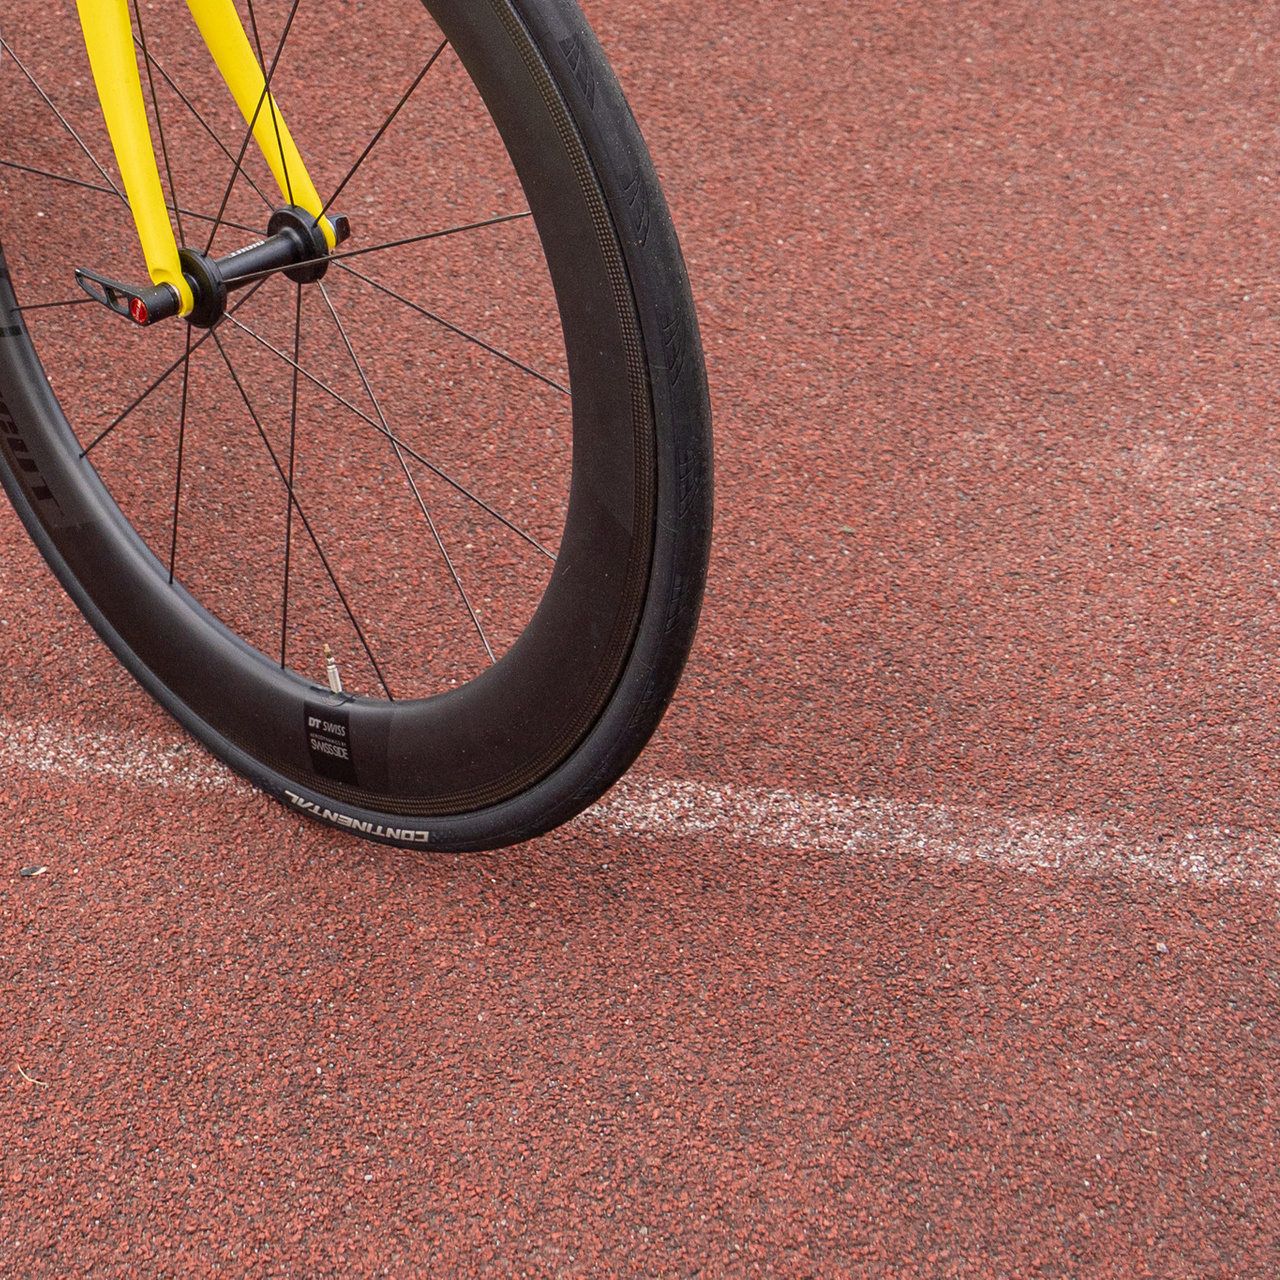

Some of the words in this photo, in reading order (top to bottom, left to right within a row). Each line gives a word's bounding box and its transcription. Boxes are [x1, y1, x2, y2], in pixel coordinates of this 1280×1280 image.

[308, 716, 322, 729] DT
[322, 721, 346, 737] SWISS
[284, 789, 429, 843] CONTINENTAL
